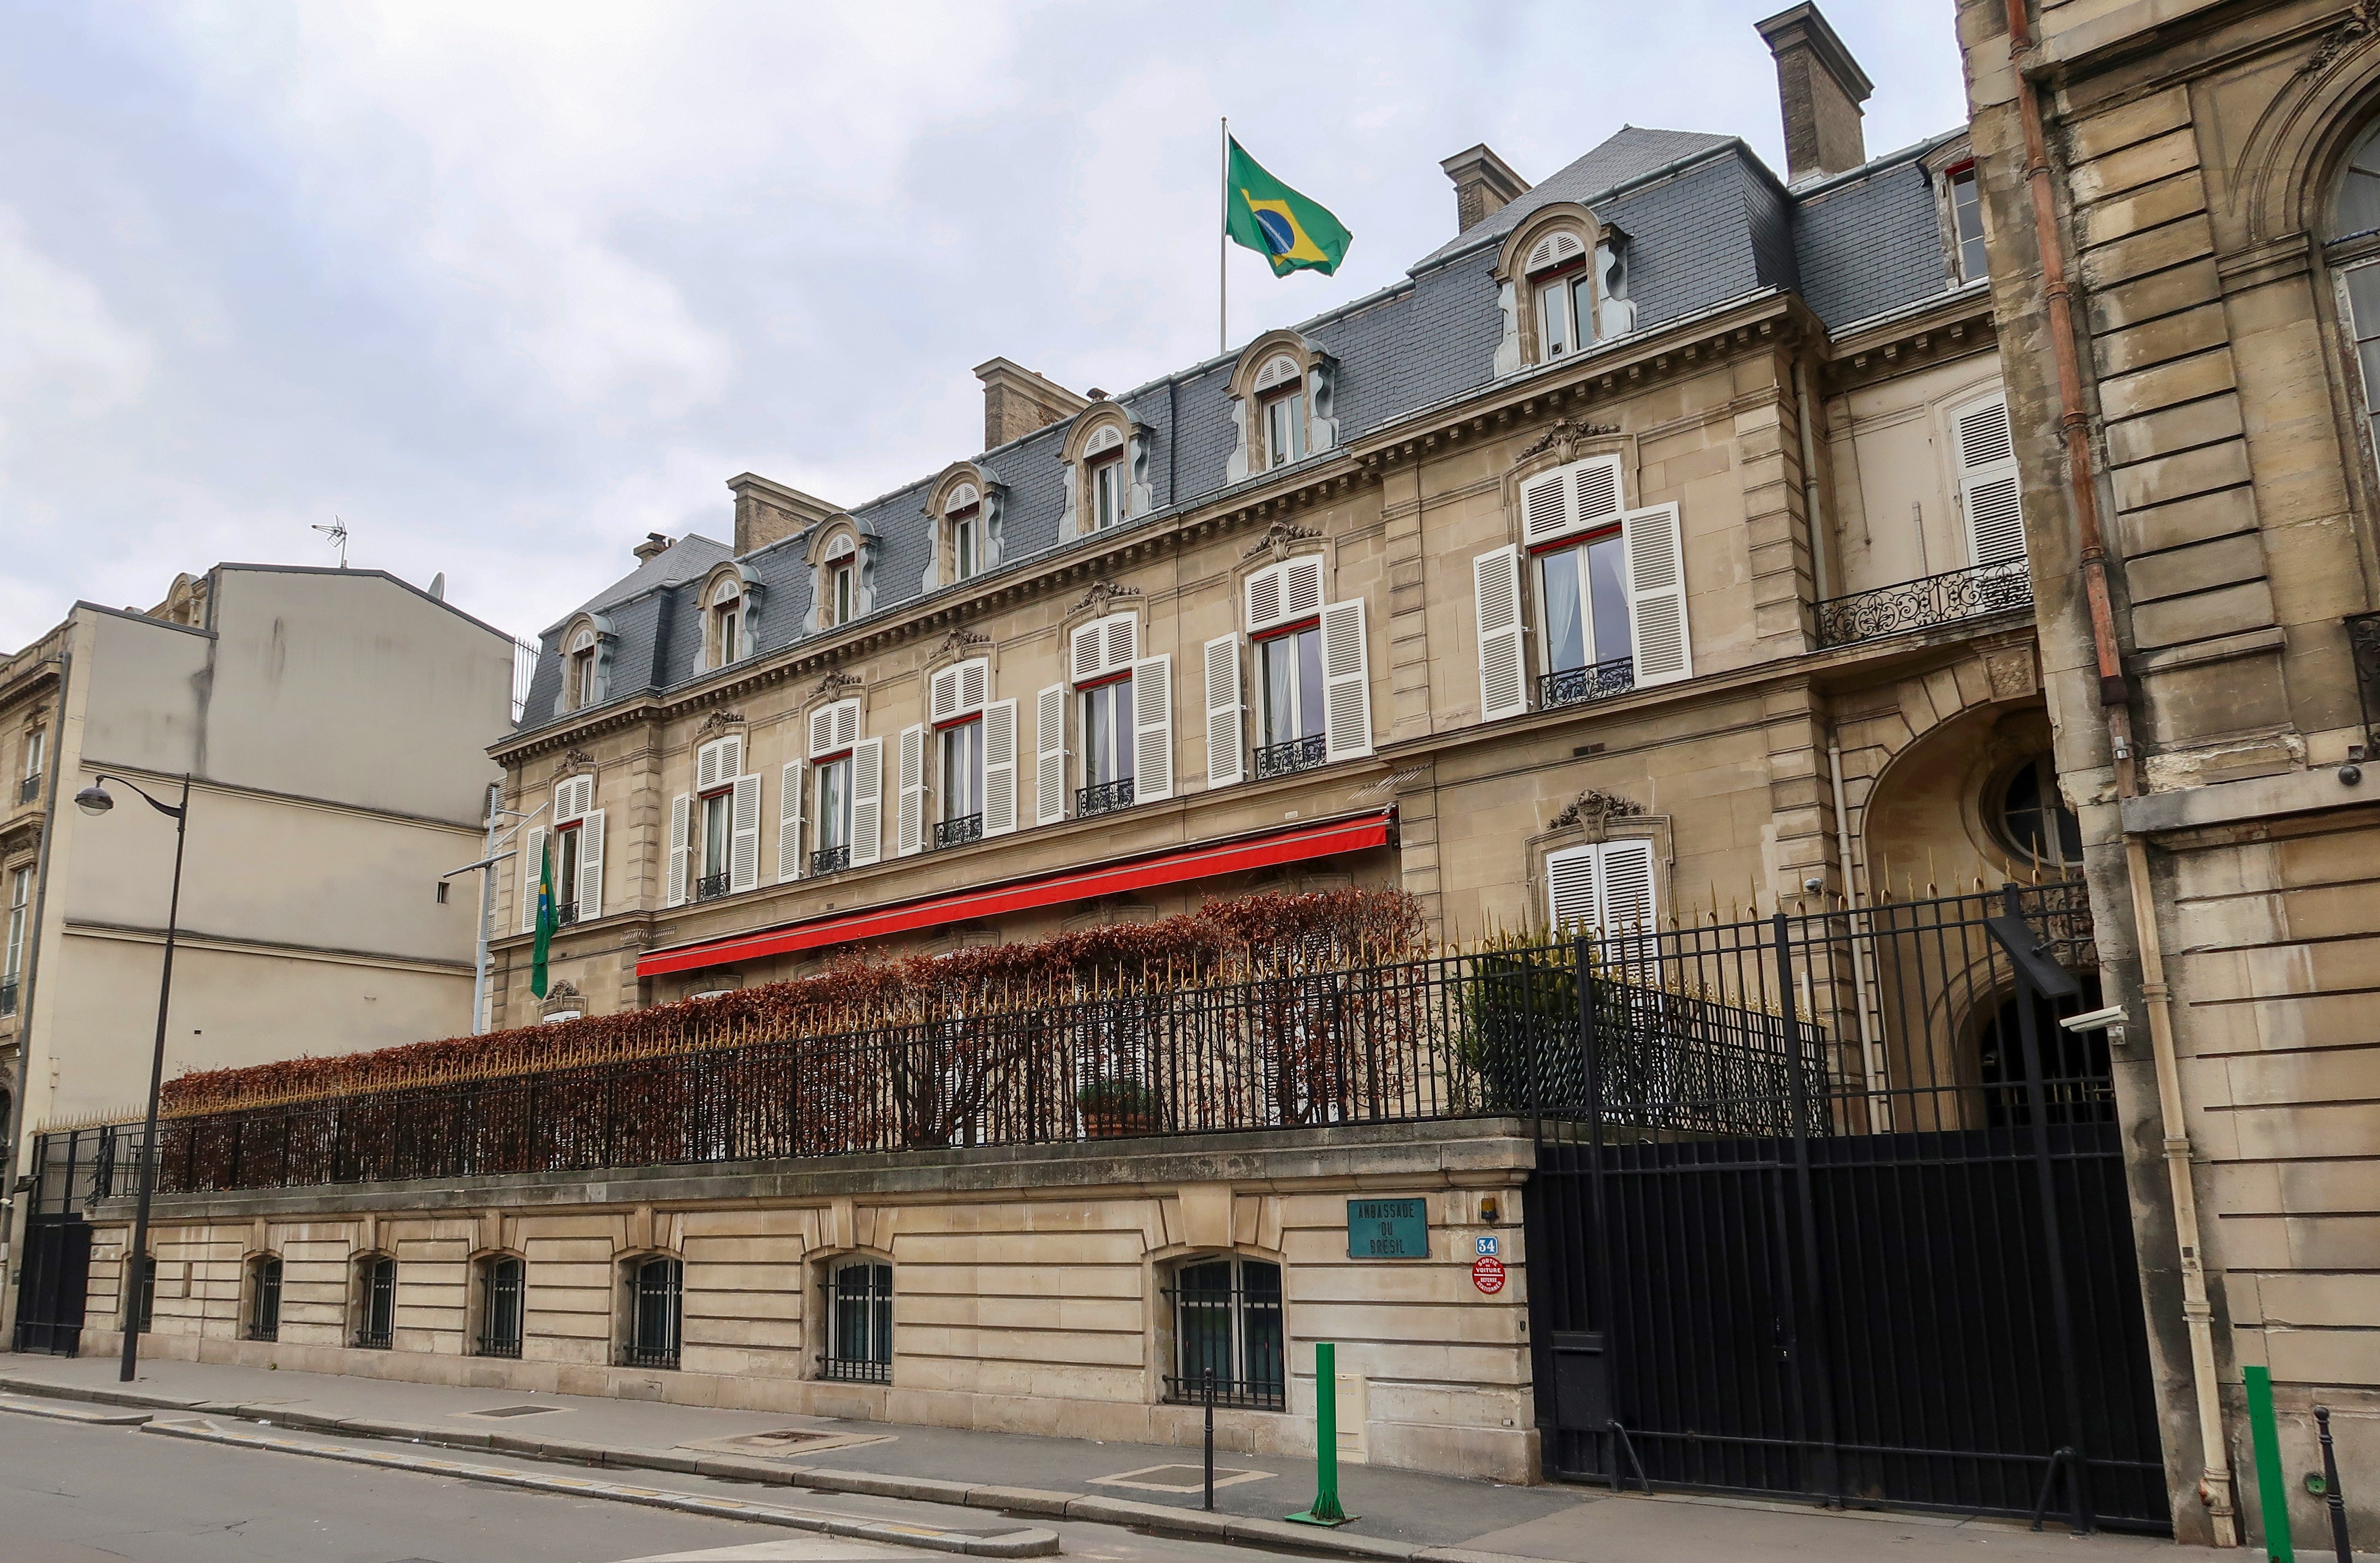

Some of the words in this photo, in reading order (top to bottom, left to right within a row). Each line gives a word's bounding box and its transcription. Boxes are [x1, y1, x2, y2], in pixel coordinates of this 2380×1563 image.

[1358, 1203, 1415, 1218] AMBASSADE
[1381, 1221, 1393, 1235] DU
[1479, 1240, 1495, 1252] 34
[1478, 1258, 1498, 1267] SORTIE
[1476, 1281, 1502, 1292] STATIONNER
